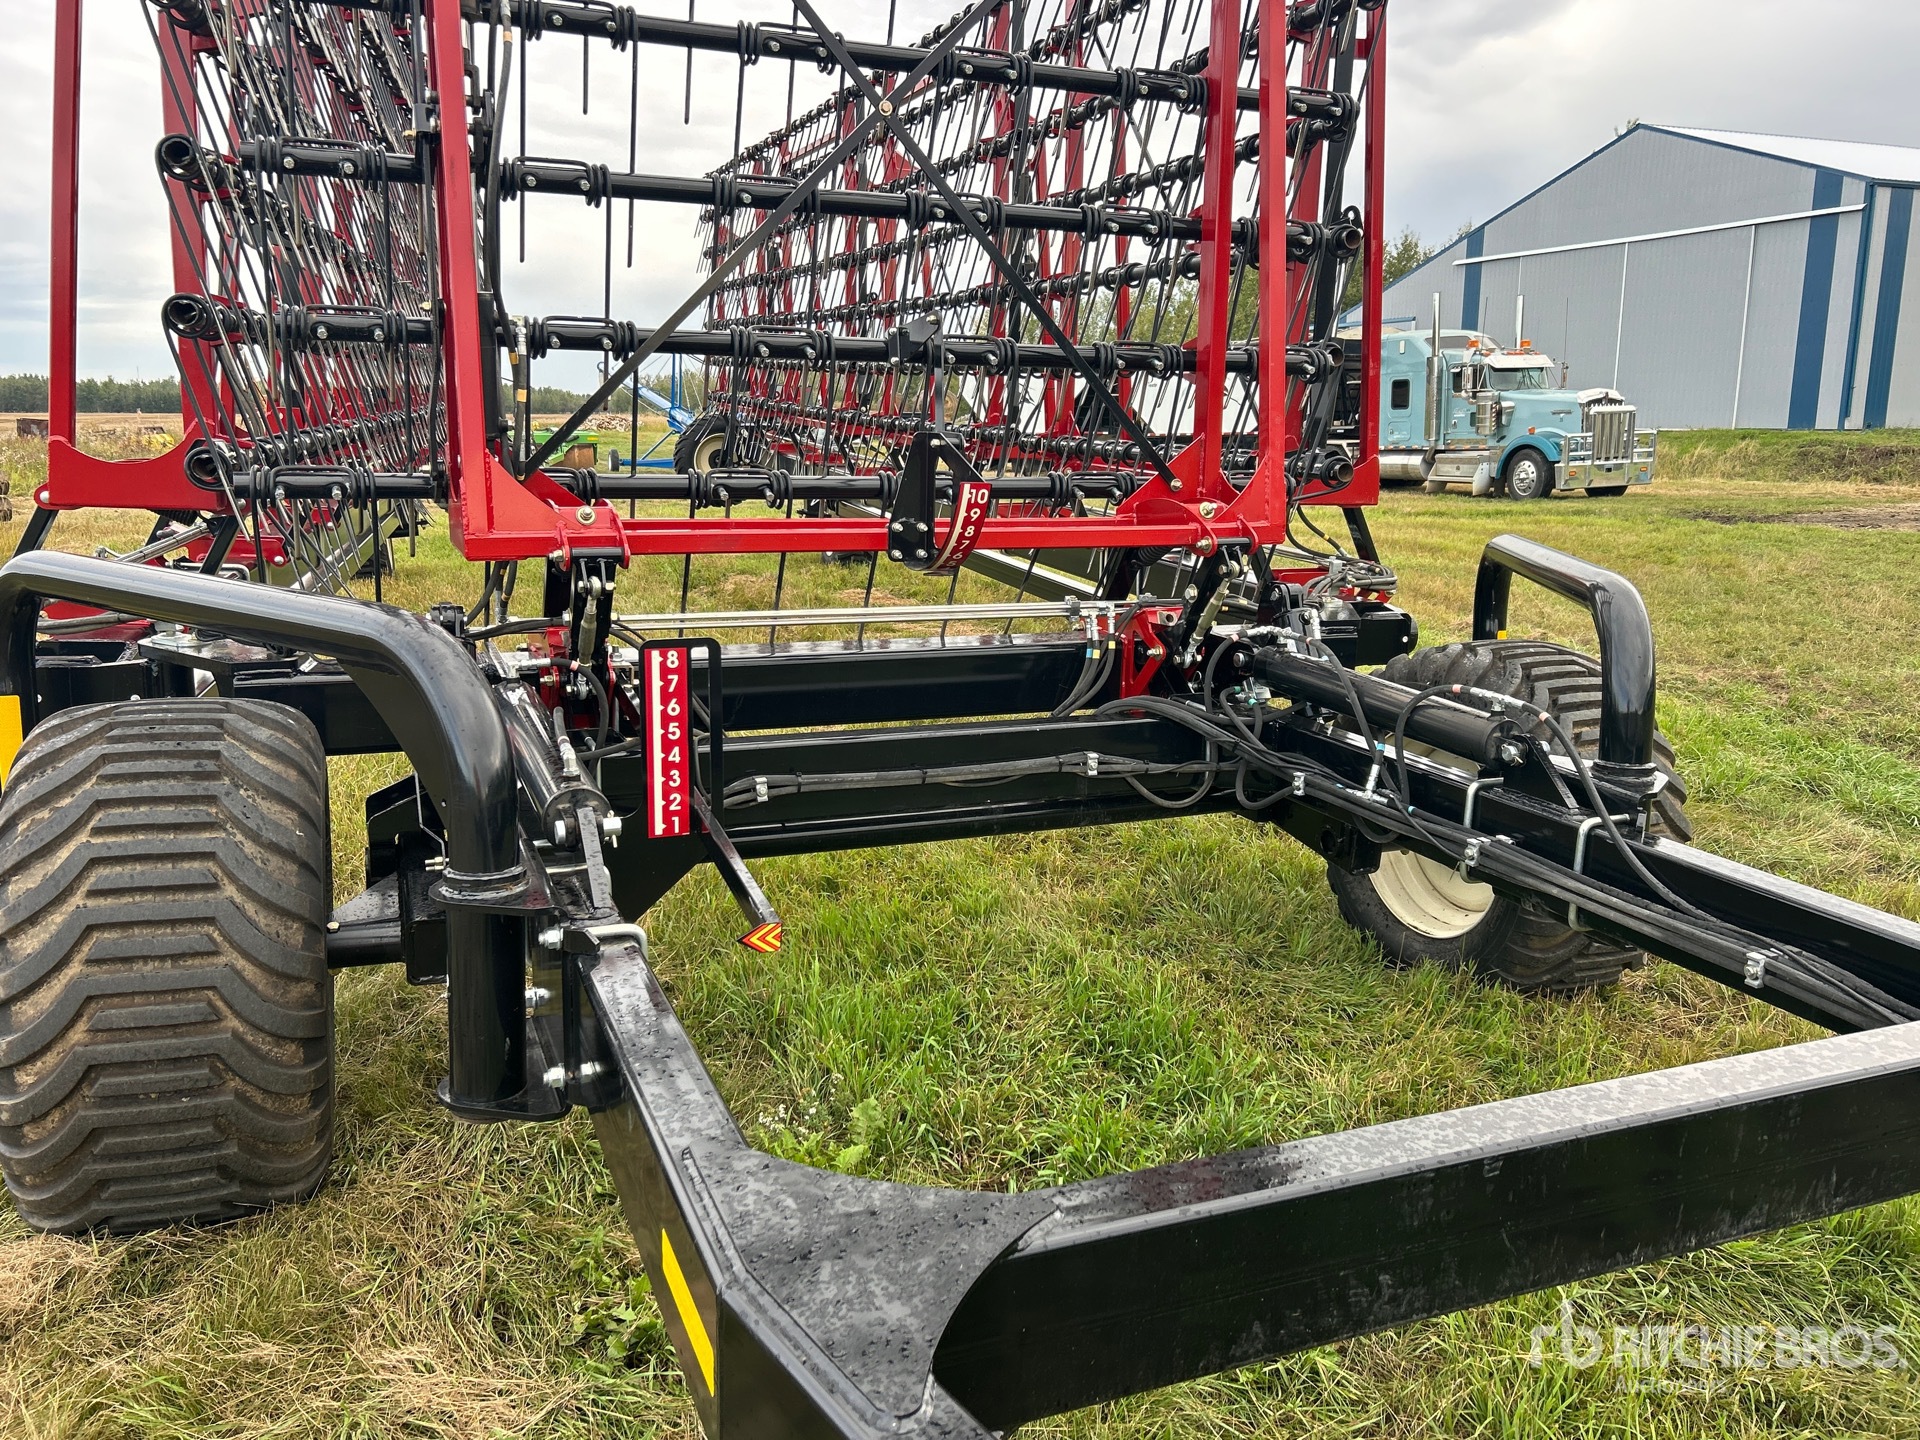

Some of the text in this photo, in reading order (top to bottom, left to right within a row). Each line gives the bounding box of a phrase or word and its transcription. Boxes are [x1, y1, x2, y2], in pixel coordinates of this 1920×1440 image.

[970, 489, 988, 504] 10
[970, 508, 981, 521] 9
[964, 525, 975, 537] 8
[959, 540, 970, 550] 7
[952, 552, 963, 560] 6
[666, 650, 679, 668] 8
[667, 675, 679, 692] 7
[667, 698, 680, 716] 6
[667, 723, 681, 740] 5
[668, 746, 681, 763] 4
[668, 770, 681, 787] 3
[668, 793, 682, 811] 2
[671, 816, 680, 834] 1
